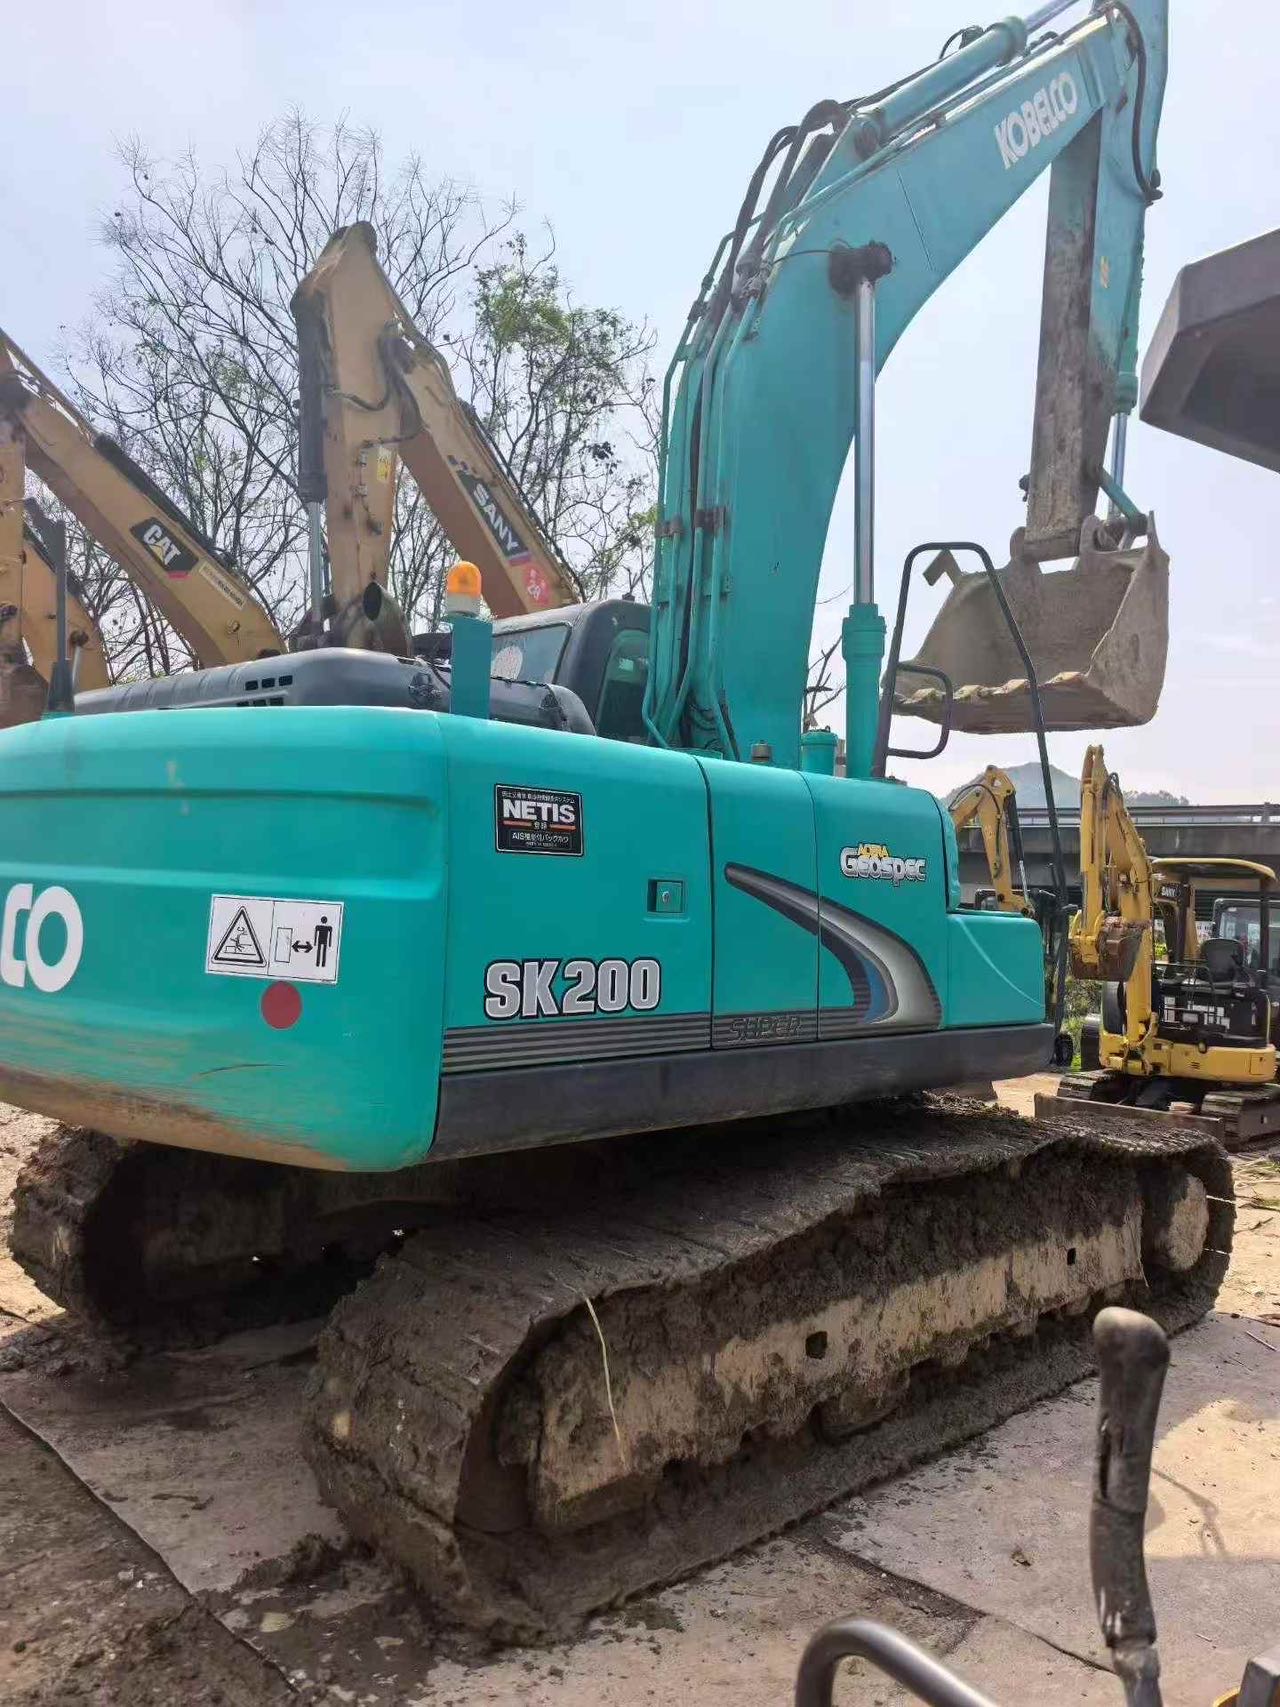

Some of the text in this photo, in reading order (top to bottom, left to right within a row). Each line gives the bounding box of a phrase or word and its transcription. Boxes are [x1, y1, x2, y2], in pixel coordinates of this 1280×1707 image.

[993, 72, 1078, 170] KOBELCO
[473, 483, 519, 551] SANY
[143, 524, 182, 565] CAT
[502, 798, 575, 823] NETIS
[485, 957, 662, 1020] SK200
[728, 1016, 803, 1043] SUPER
